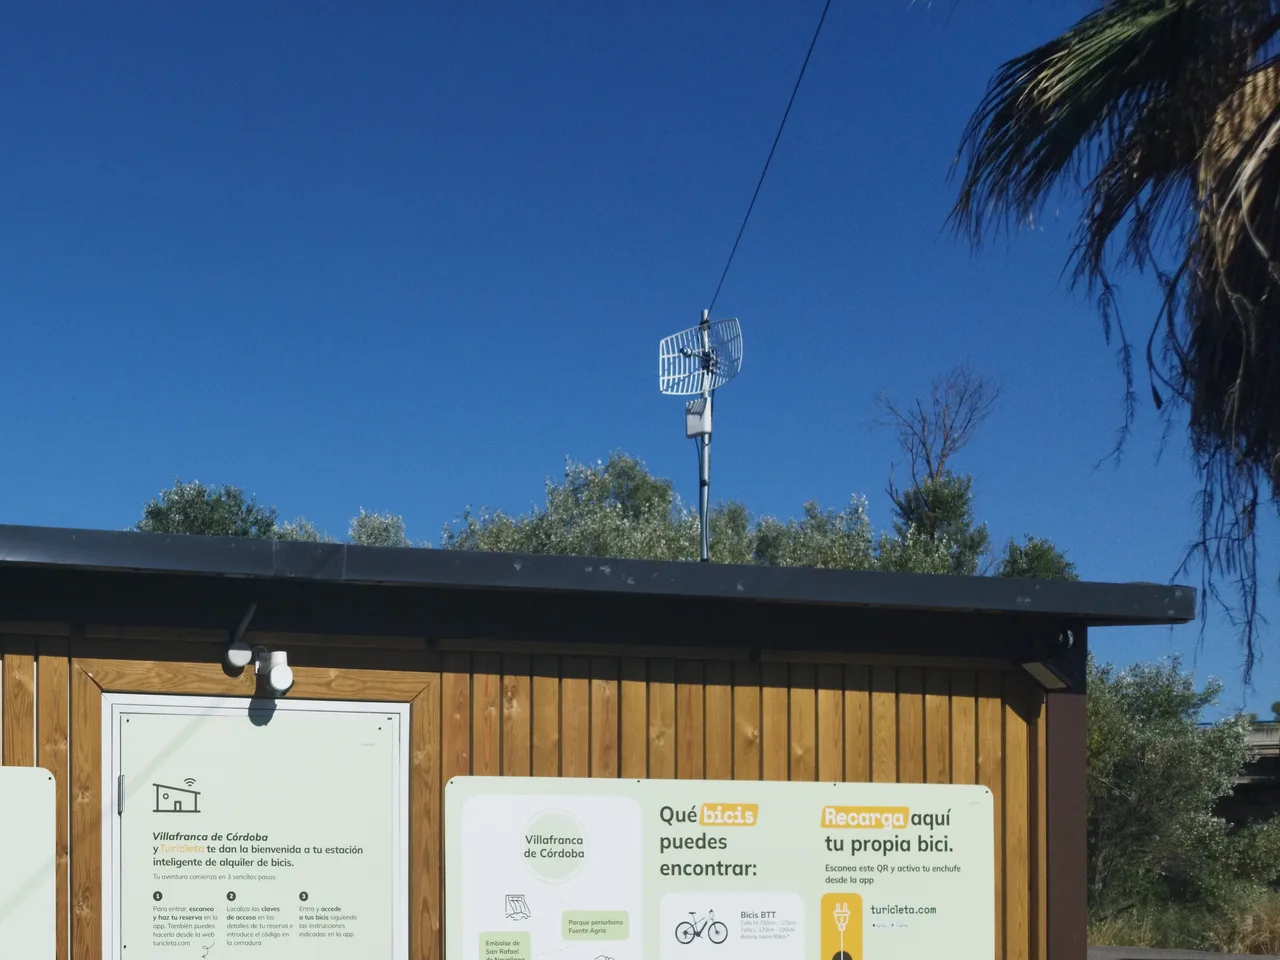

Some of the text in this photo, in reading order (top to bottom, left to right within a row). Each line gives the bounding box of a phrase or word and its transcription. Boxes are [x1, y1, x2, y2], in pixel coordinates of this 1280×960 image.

[660, 805, 754, 826] Qué bicis
[825, 808, 951, 830] Recarga aquí
[153, 832, 268, 841] Villafranca de Córdoba
[525, 835, 583, 845] Villafranca
[660, 833, 727, 853] puedes
[825, 835, 953, 856] tu propia bici.
[153, 847, 159, 855] y
[160, 844, 205, 853] Turicleta
[207, 845, 216, 853] te
[219, 845, 237, 853] dan
[240, 845, 248, 853] la
[252, 845, 301, 854] bienvenida
[313, 846, 322, 854] tu
[325, 845, 363, 854] estación
[524, 848, 584, 858] de Córdoba
[153, 858, 294, 869] inteligente de alquiler de bicis.
[660, 861, 756, 876] encontrar:
[825, 864, 857, 872] Escanea
[877, 864, 888, 873] QR
[825, 876, 848, 884] desde
[850, 876, 857, 884] la
[870, 905, 936, 914] turicleta.com
[741, 911, 776, 919] Bicis BTT
